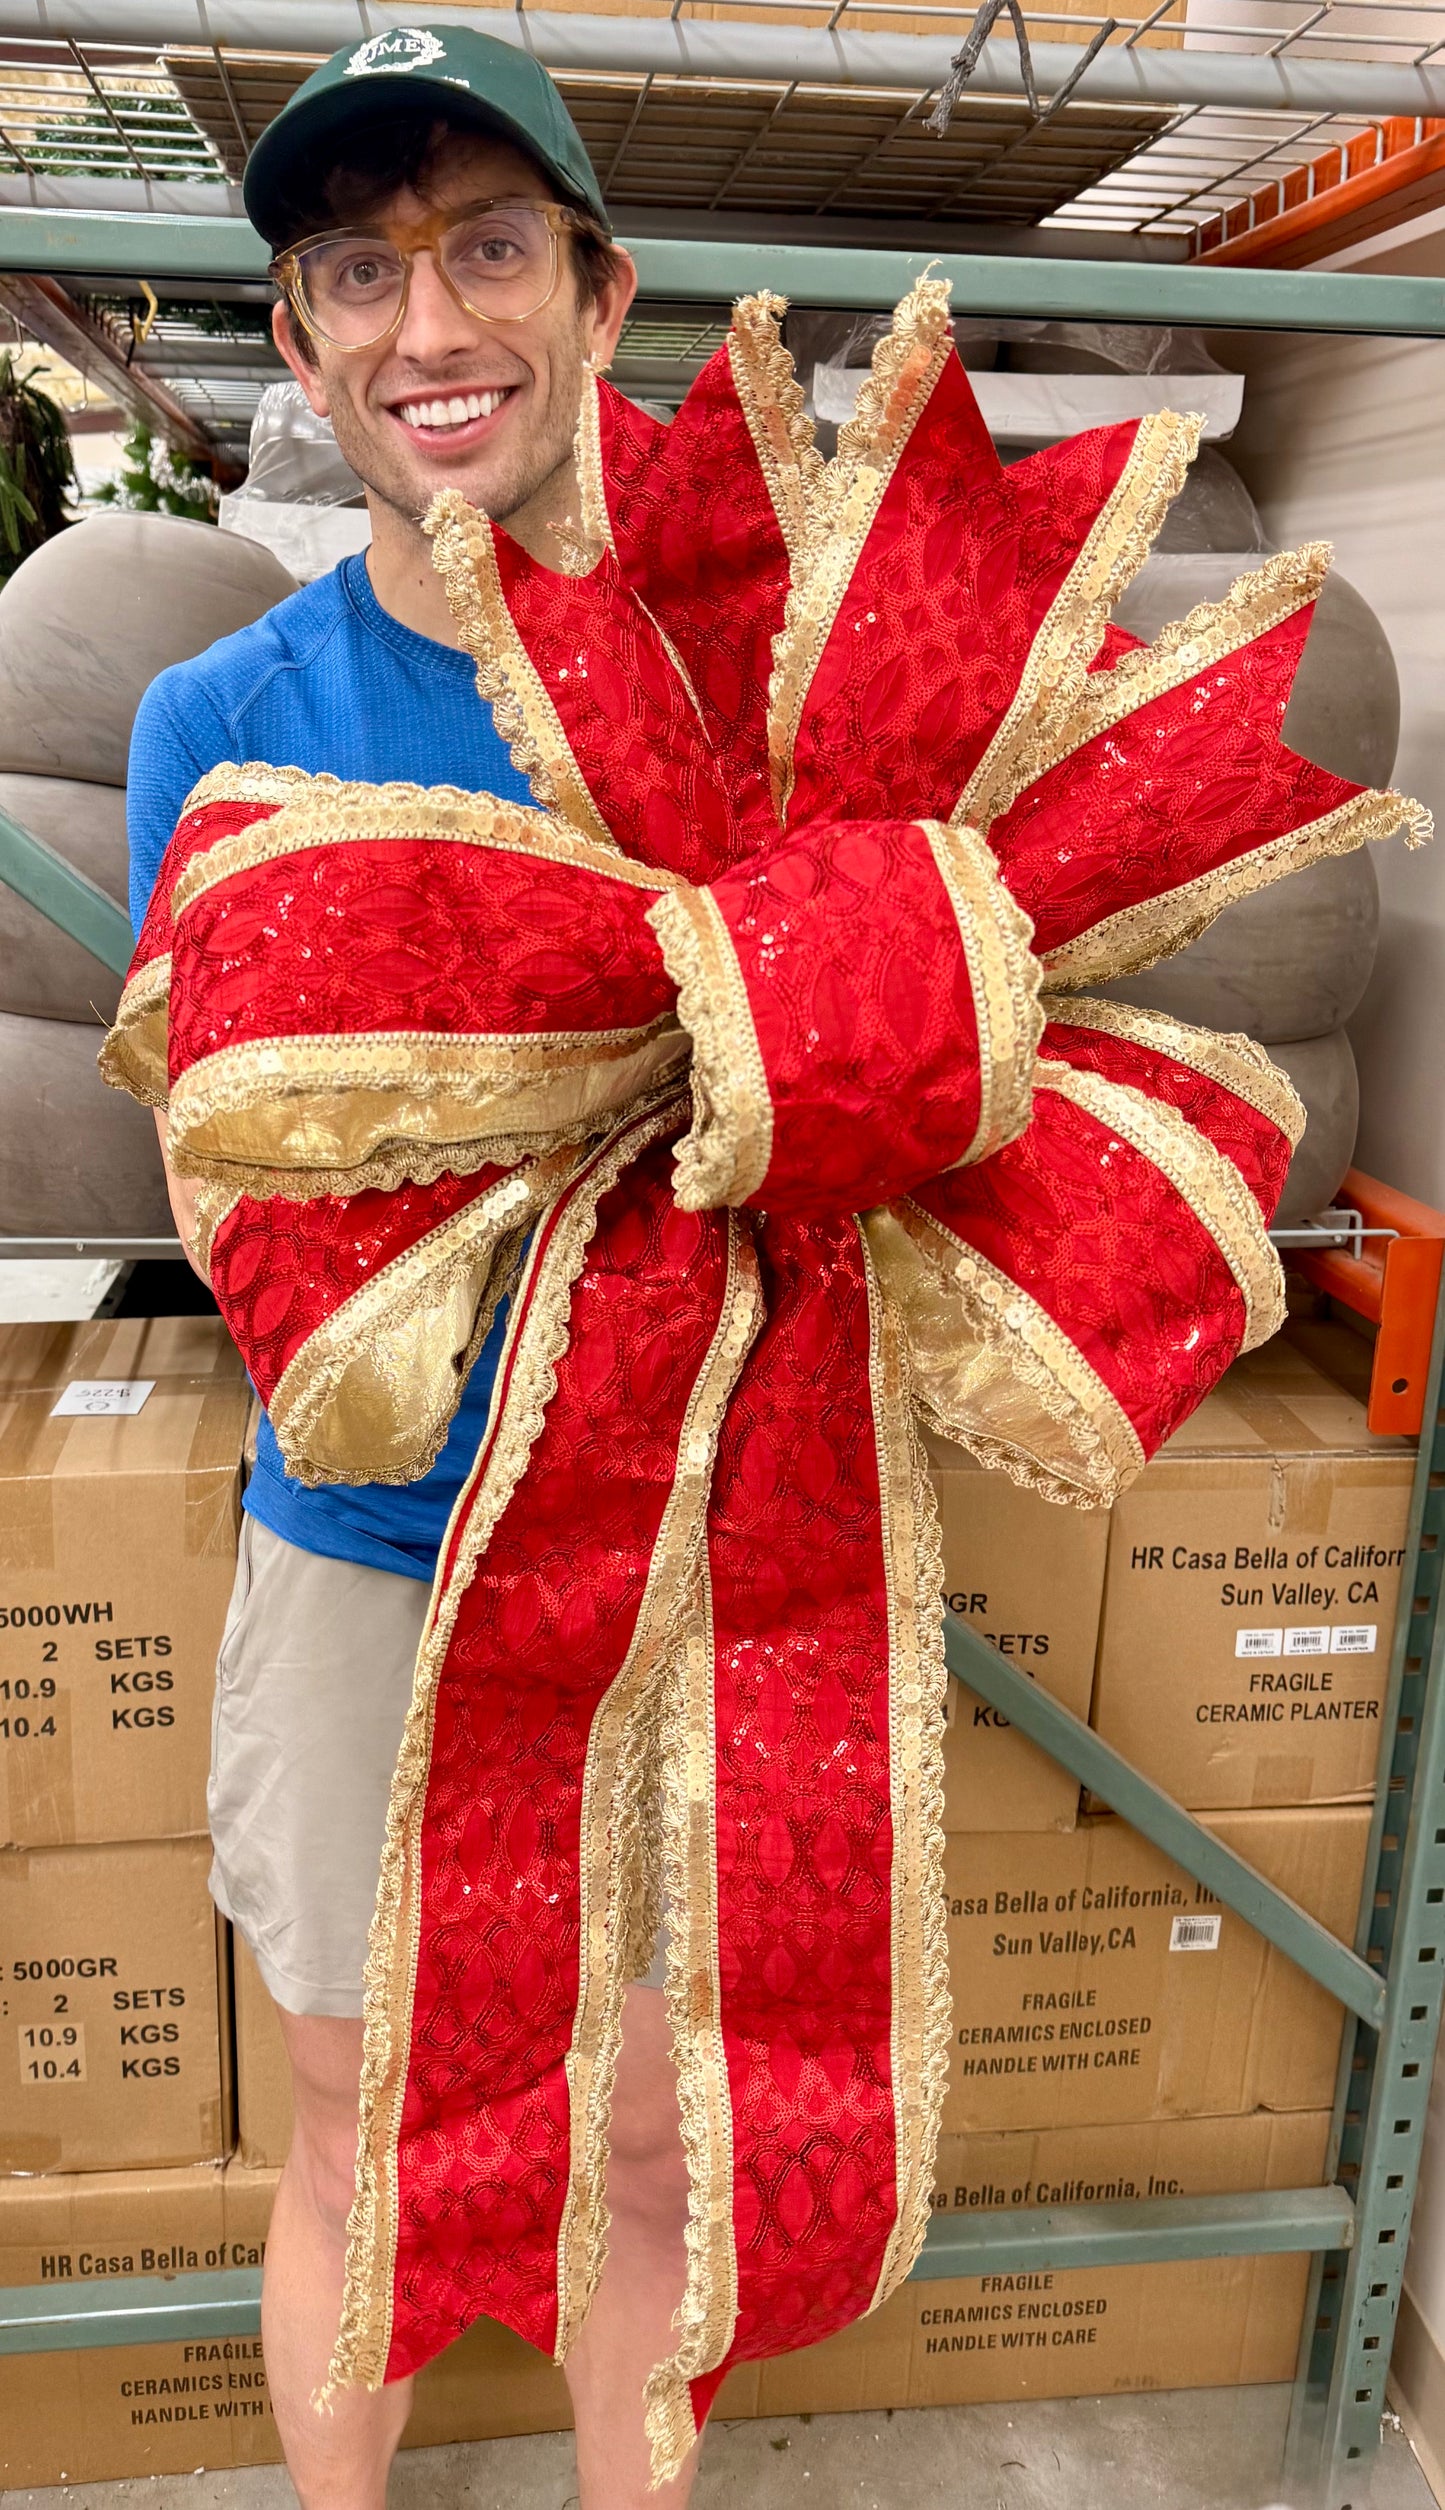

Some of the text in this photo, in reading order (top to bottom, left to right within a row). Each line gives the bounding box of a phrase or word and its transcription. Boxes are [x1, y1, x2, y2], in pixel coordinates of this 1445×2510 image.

[1131, 1546, 1164, 1570] HR
[1172, 1546, 1227, 1570] Casa
[1234, 1546, 1289, 1570] Bella
[1296, 1545, 1320, 1569] of
[1220, 1583, 1264, 1606] Sun
[1347, 1580, 1379, 1604] CA
[42, 1635, 173, 1663] 2 SETS
[0, 1670, 174, 1701] 10.9 KGS
[1249, 1672, 1333, 1693] FRAGILE
[0, 1705, 175, 1739] 10.4 KGS
[1196, 1700, 1379, 1724] CERAMIC PLANTER
[994, 1890, 1049, 1915] Bella
[1054, 1888, 1078, 1913] of
[1081, 1883, 1188, 1911] California,
[992, 1933, 1033, 1957] Sun
[13, 1957, 118, 1982] 5000GR
[53, 1987, 186, 2014] 2 SETS
[1022, 1989, 1097, 2011] FRAGILE
[24, 2023, 180, 2048] 10.9 KGS
[958, 2016, 1152, 2046] CERAMICS ENCLOSED
[28, 2056, 181, 2080] 10.4 KGS
[963, 2048, 1141, 2076] HANDLE WITH CARE
[953, 2184, 1006, 2208] Bella
[1011, 2180, 1032, 2205] of
[1036, 2177, 1141, 2204] California,
[1147, 2174, 1184, 2197] Inc.
[41, 2241, 266, 2279] HR Casa Bella of Cal
[981, 2274, 1054, 2293] FRAGILE
[920, 2298, 1107, 2326] CERAMICS ENCLOSED
[183, 2342, 264, 2363] FRAGILE
[926, 2327, 1097, 2354] HANDLE WITH CARE
[120, 2371, 265, 2398] CERAMICS ENC
[131, 2404, 210, 2426] HANDLE
[213, 2400, 264, 2418] WITH
